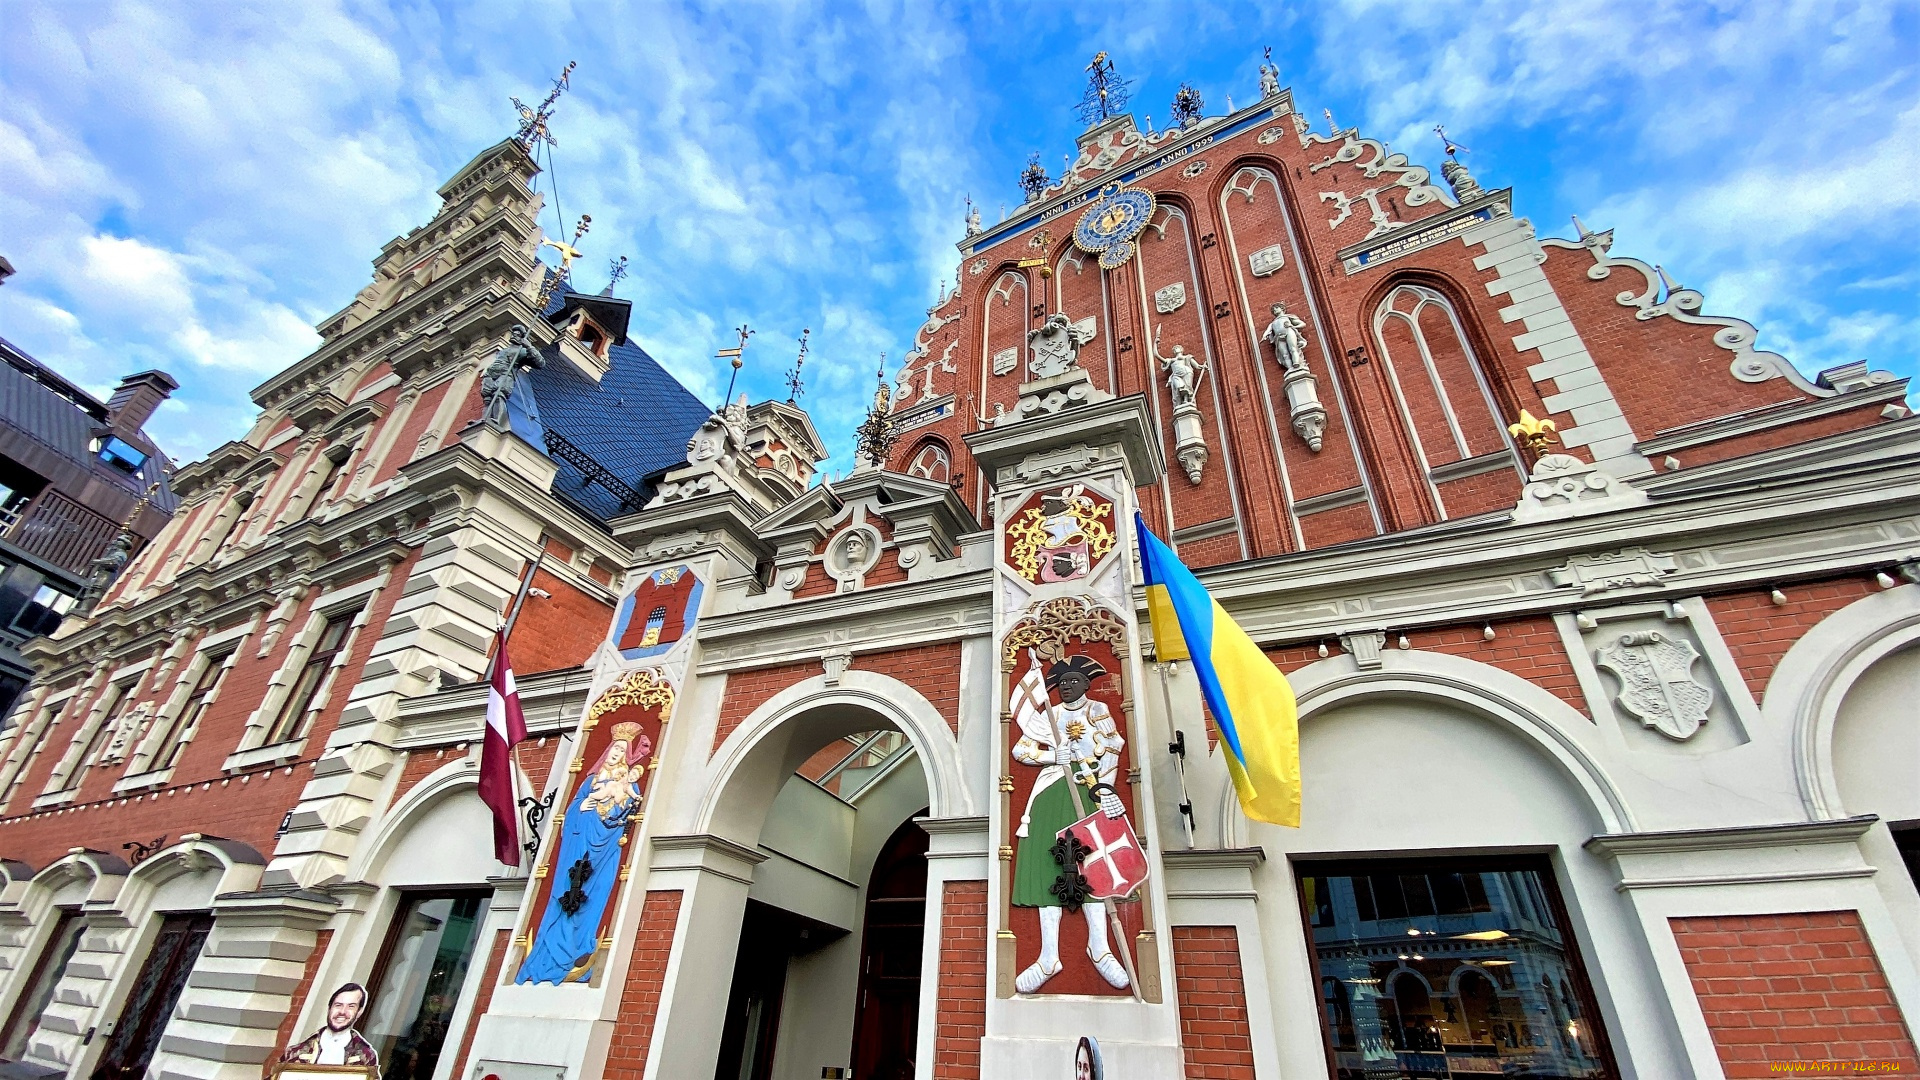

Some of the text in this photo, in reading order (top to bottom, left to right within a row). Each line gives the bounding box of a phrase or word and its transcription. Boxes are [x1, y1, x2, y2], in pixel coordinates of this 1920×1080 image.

[1040, 204, 1064, 221] ANNO
[1067, 193, 1088, 209] 1334
[1160, 147, 1188, 165] ANNO
[1191, 135, 1214, 152] 1999
